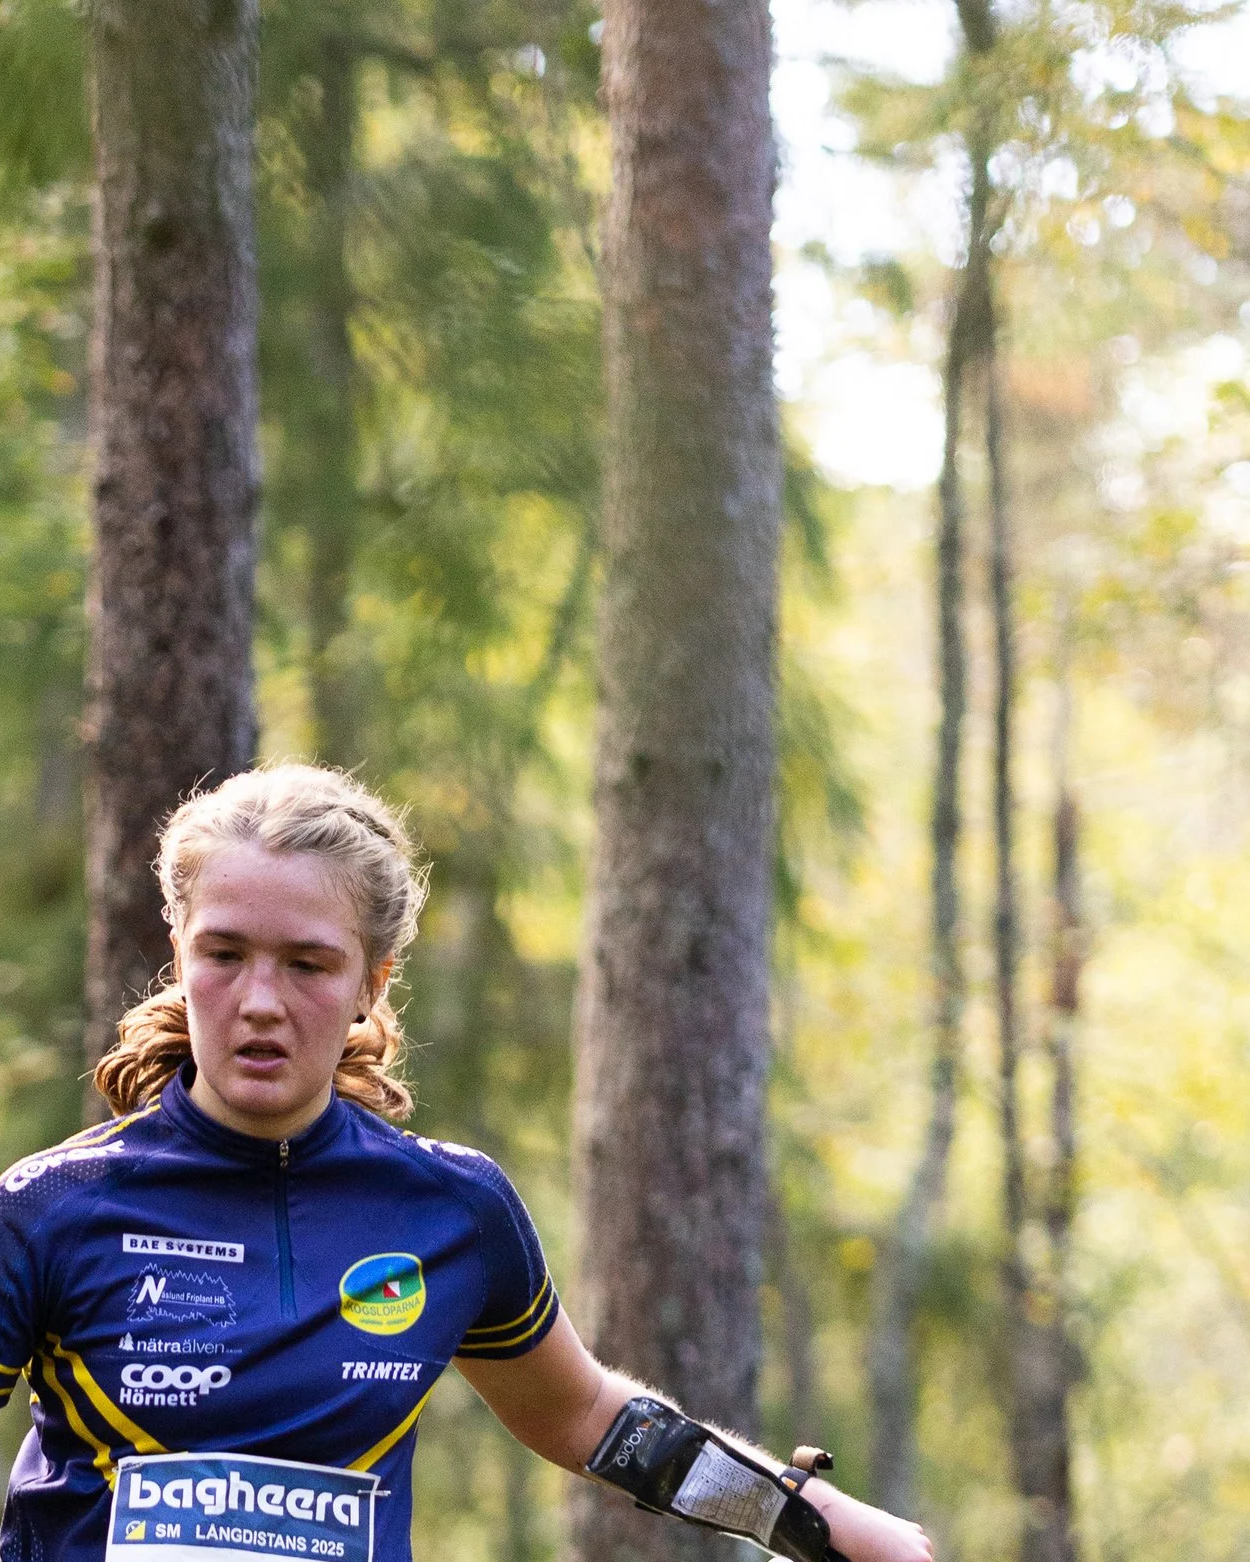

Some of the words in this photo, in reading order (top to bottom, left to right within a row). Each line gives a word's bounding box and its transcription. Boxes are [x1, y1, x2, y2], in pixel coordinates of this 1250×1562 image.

[130, 1239, 159, 1250] BAE
[166, 1241, 237, 1257] SYSTEMS
[214, 1295, 225, 1304] HB
[137, 1338, 224, 1353] nätraälven
[121, 1363, 231, 1395] coop
[342, 1361, 422, 1381] TRIMTEX
[119, 1387, 197, 1406] Hörnett
[128, 1471, 359, 1526] bagheera
[155, 1523, 181, 1538] SM
[311, 1539, 344, 1557] 2025
